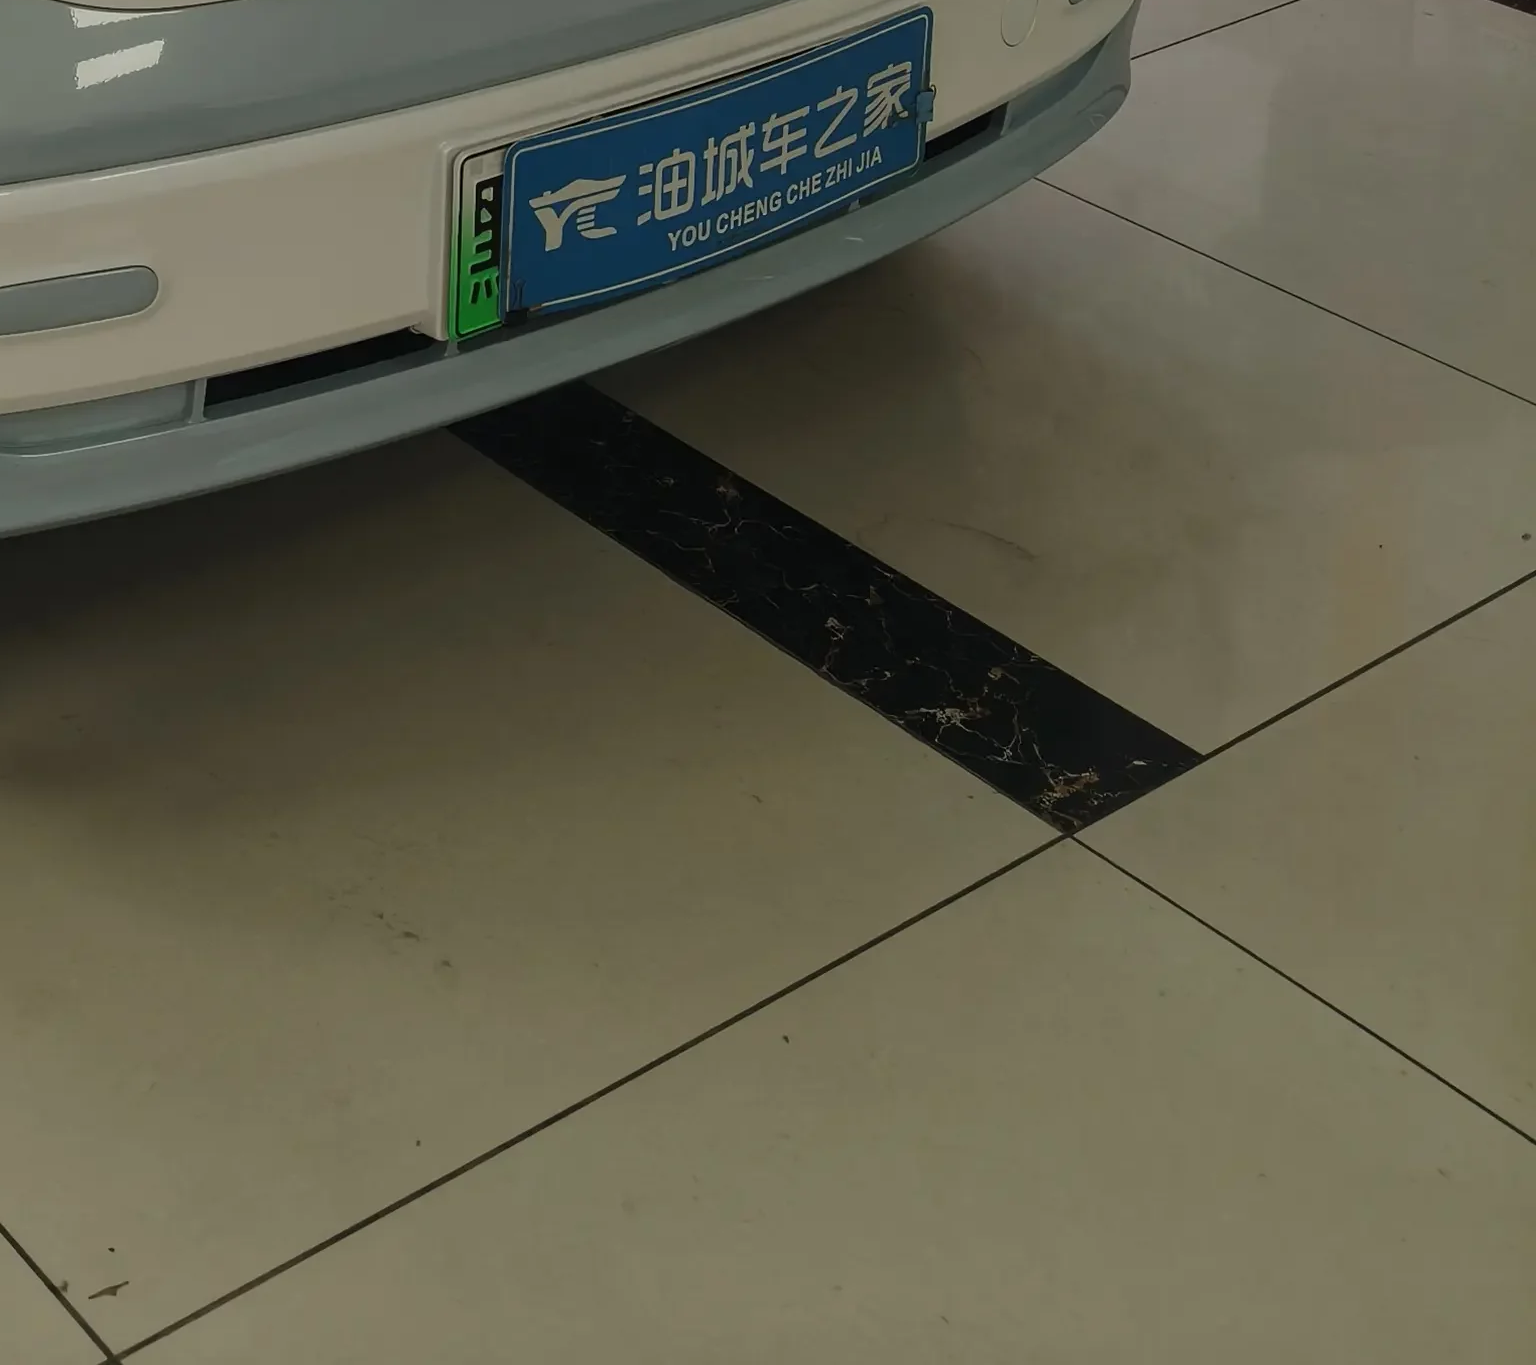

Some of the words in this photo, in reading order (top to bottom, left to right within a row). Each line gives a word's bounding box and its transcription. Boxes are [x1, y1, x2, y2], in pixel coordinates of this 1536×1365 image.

[636, 60, 912, 226] 油城车之家
[667, 219, 712, 252] YOU
[715, 188, 783, 235] CHENG
[786, 173, 823, 206] CHE
[825, 161, 853, 190] ZHI
[855, 145, 884, 175] JIA
